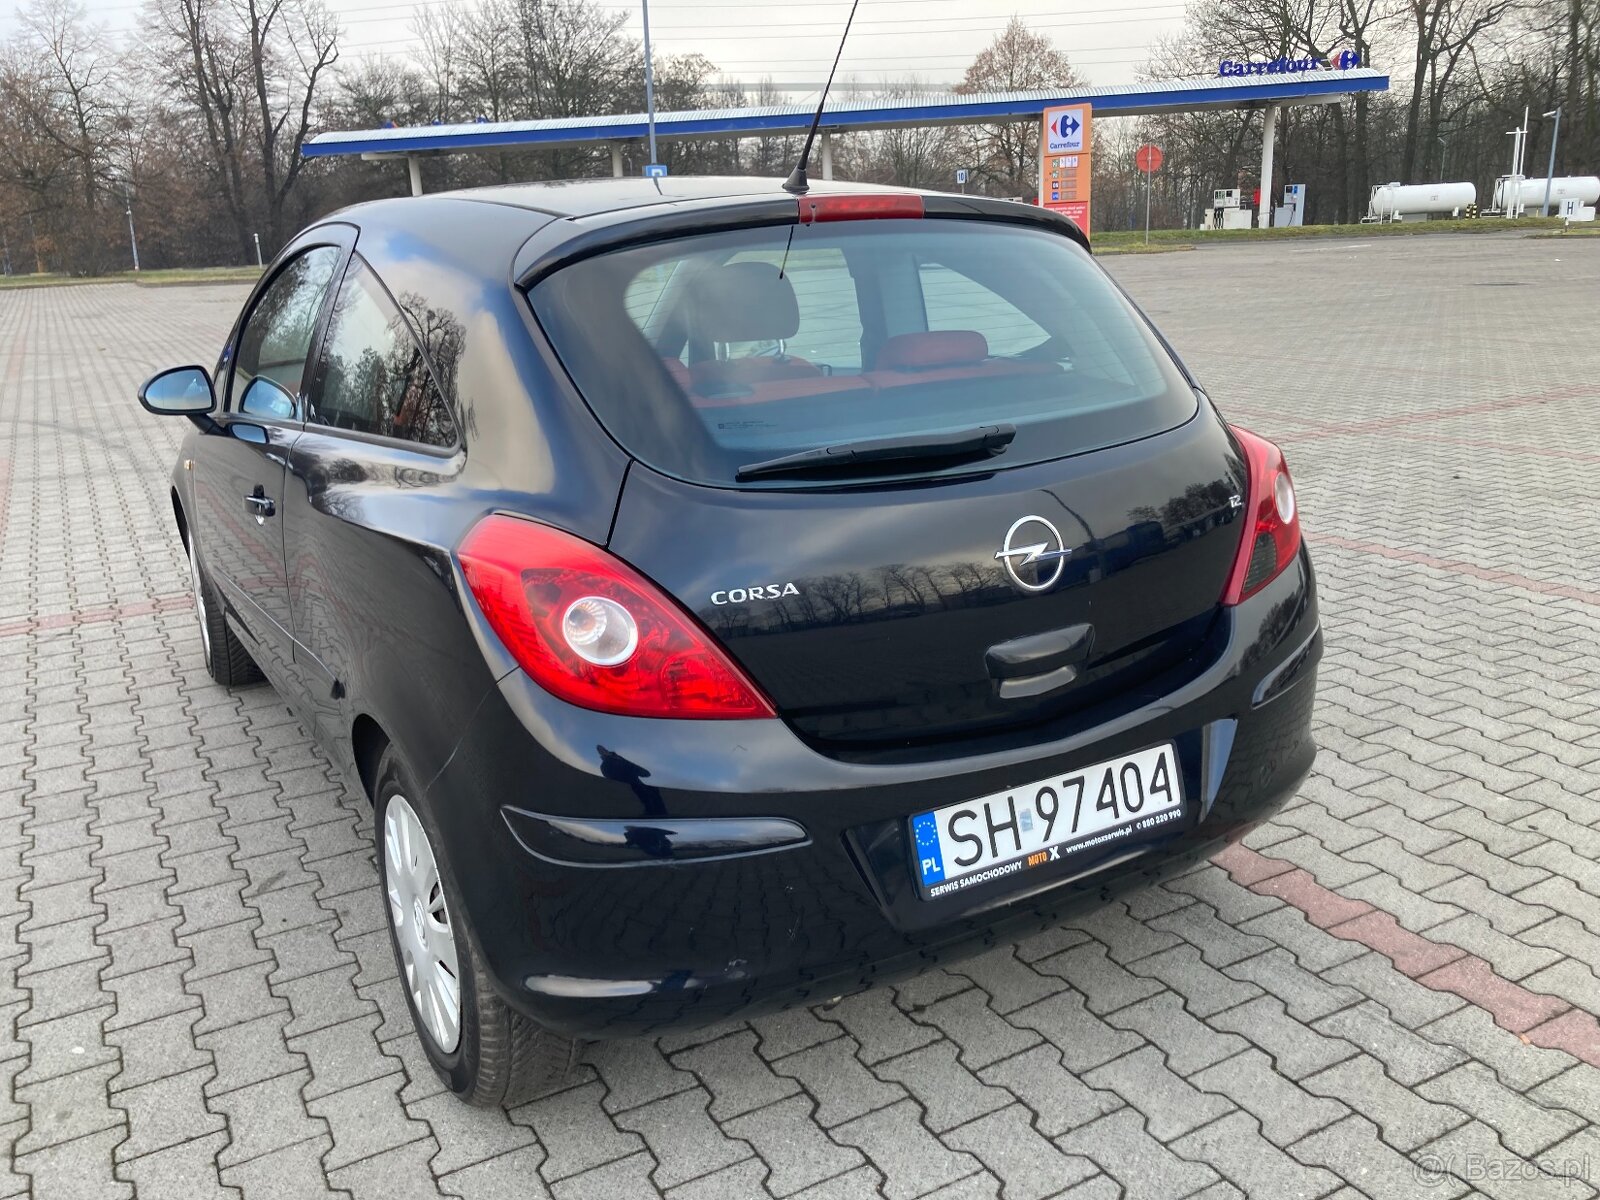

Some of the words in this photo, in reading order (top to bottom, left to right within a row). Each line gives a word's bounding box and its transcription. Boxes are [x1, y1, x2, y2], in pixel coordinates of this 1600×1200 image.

[1219, 56, 1321, 77] Carrefour
[1049, 141, 1080, 150] Carrefour
[1566, 201, 1574, 215] H
[710, 582, 800, 605] CORSA
[947, 796, 1022, 867] SH
[1035, 752, 1173, 842] 97404
[930, 880, 959, 898] SERWIS
[959, 860, 1023, 888] SAMOCHODOWY
[1027, 851, 1048, 867] MOTO
[1048, 845, 1061, 861] X
[1066, 825, 1133, 854] www.motoxserwis.pl
[1168, 808, 1182, 819] 990
[921, 856, 942, 876] PL
